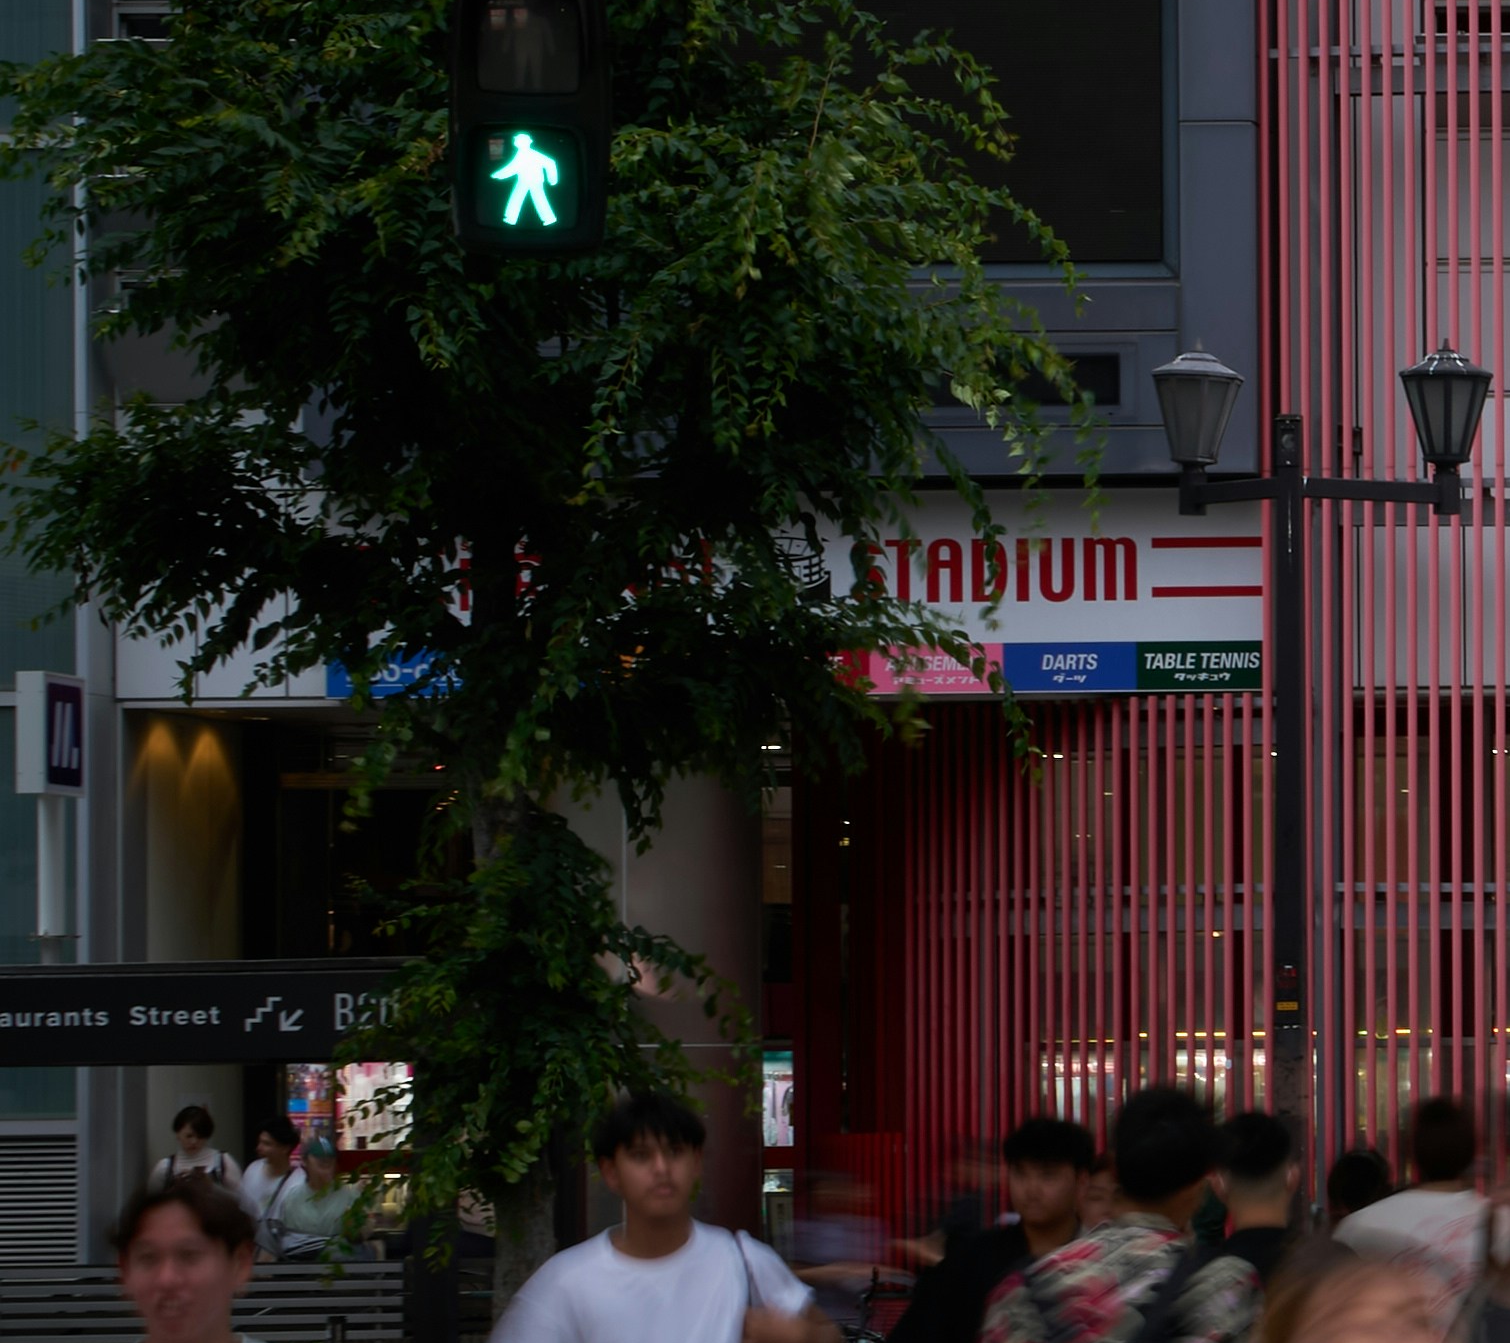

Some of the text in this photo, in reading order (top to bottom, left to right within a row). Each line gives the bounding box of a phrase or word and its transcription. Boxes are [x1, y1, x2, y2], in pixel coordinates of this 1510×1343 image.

[1041, 653, 1099, 671] DARTS
[1144, 651, 1261, 670] TABLE TENNIS
[1052, 673, 1088, 684] ダーツ
[128, 1004, 222, 1026] Street
